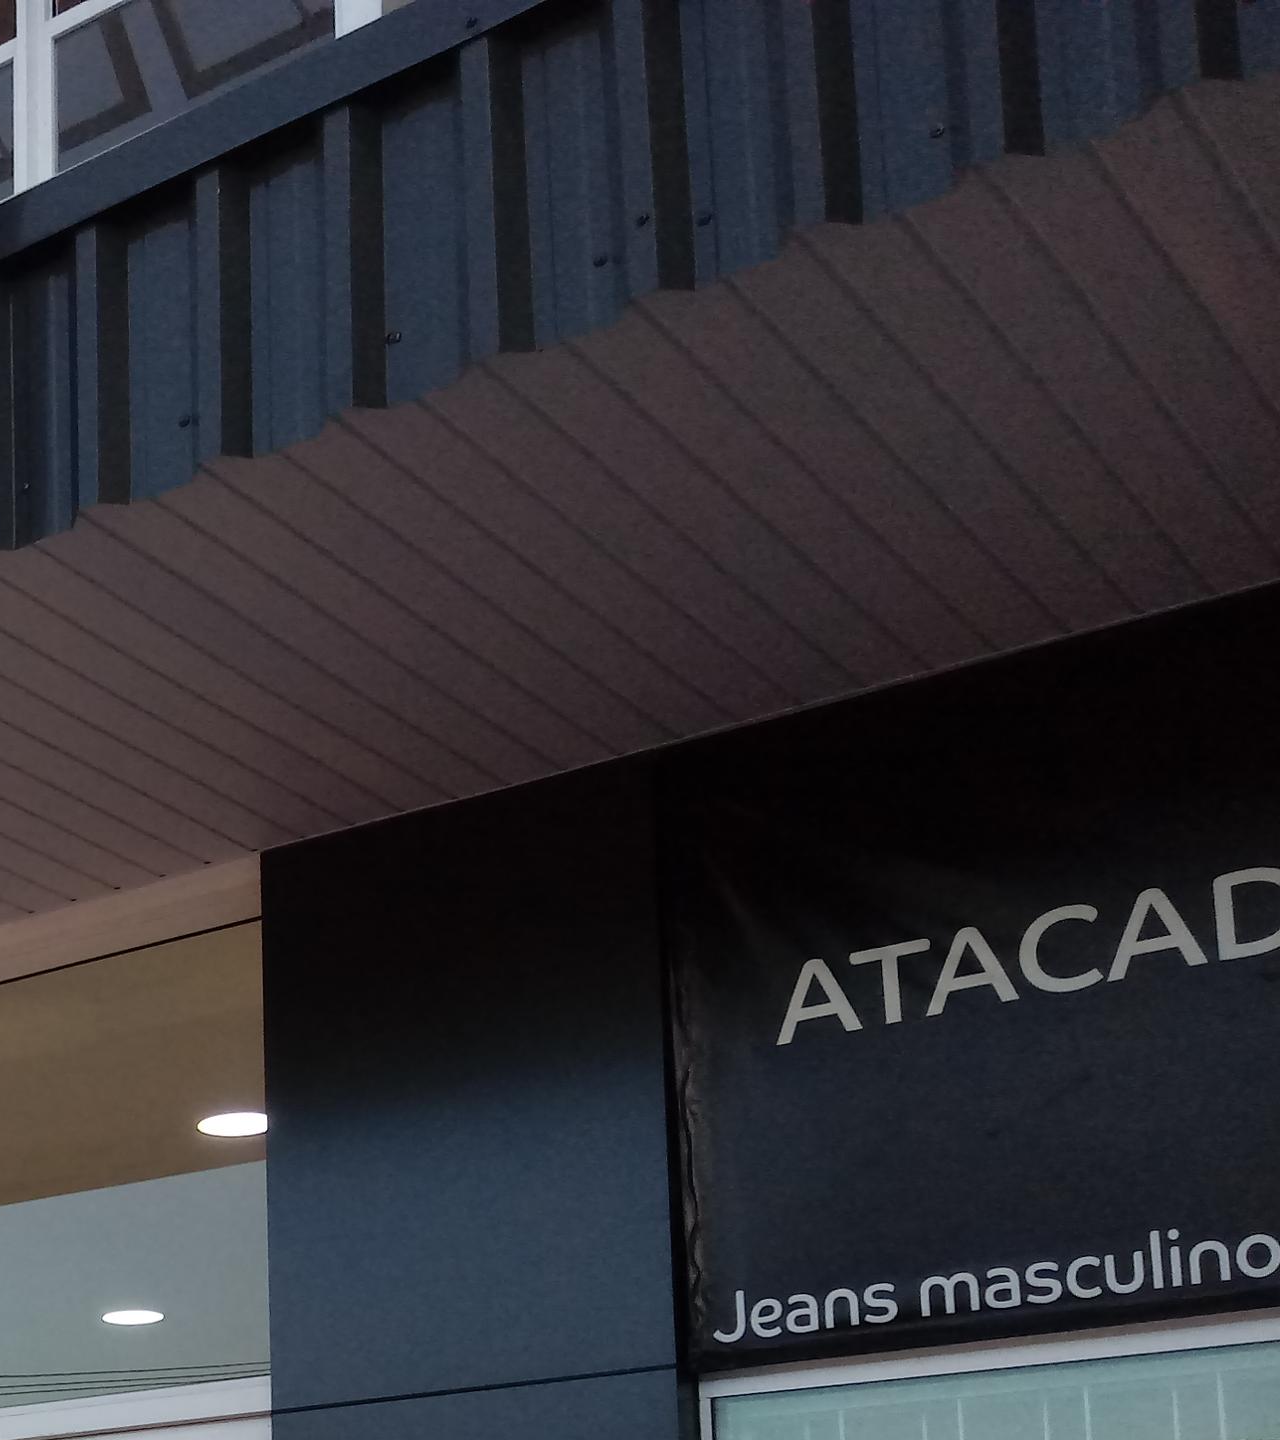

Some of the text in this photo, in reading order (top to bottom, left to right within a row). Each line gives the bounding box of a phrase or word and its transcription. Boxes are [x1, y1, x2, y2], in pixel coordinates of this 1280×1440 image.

[776, 866, 1280, 1046] ATACAD
[713, 1228, 1280, 1343] Jeans masculino
